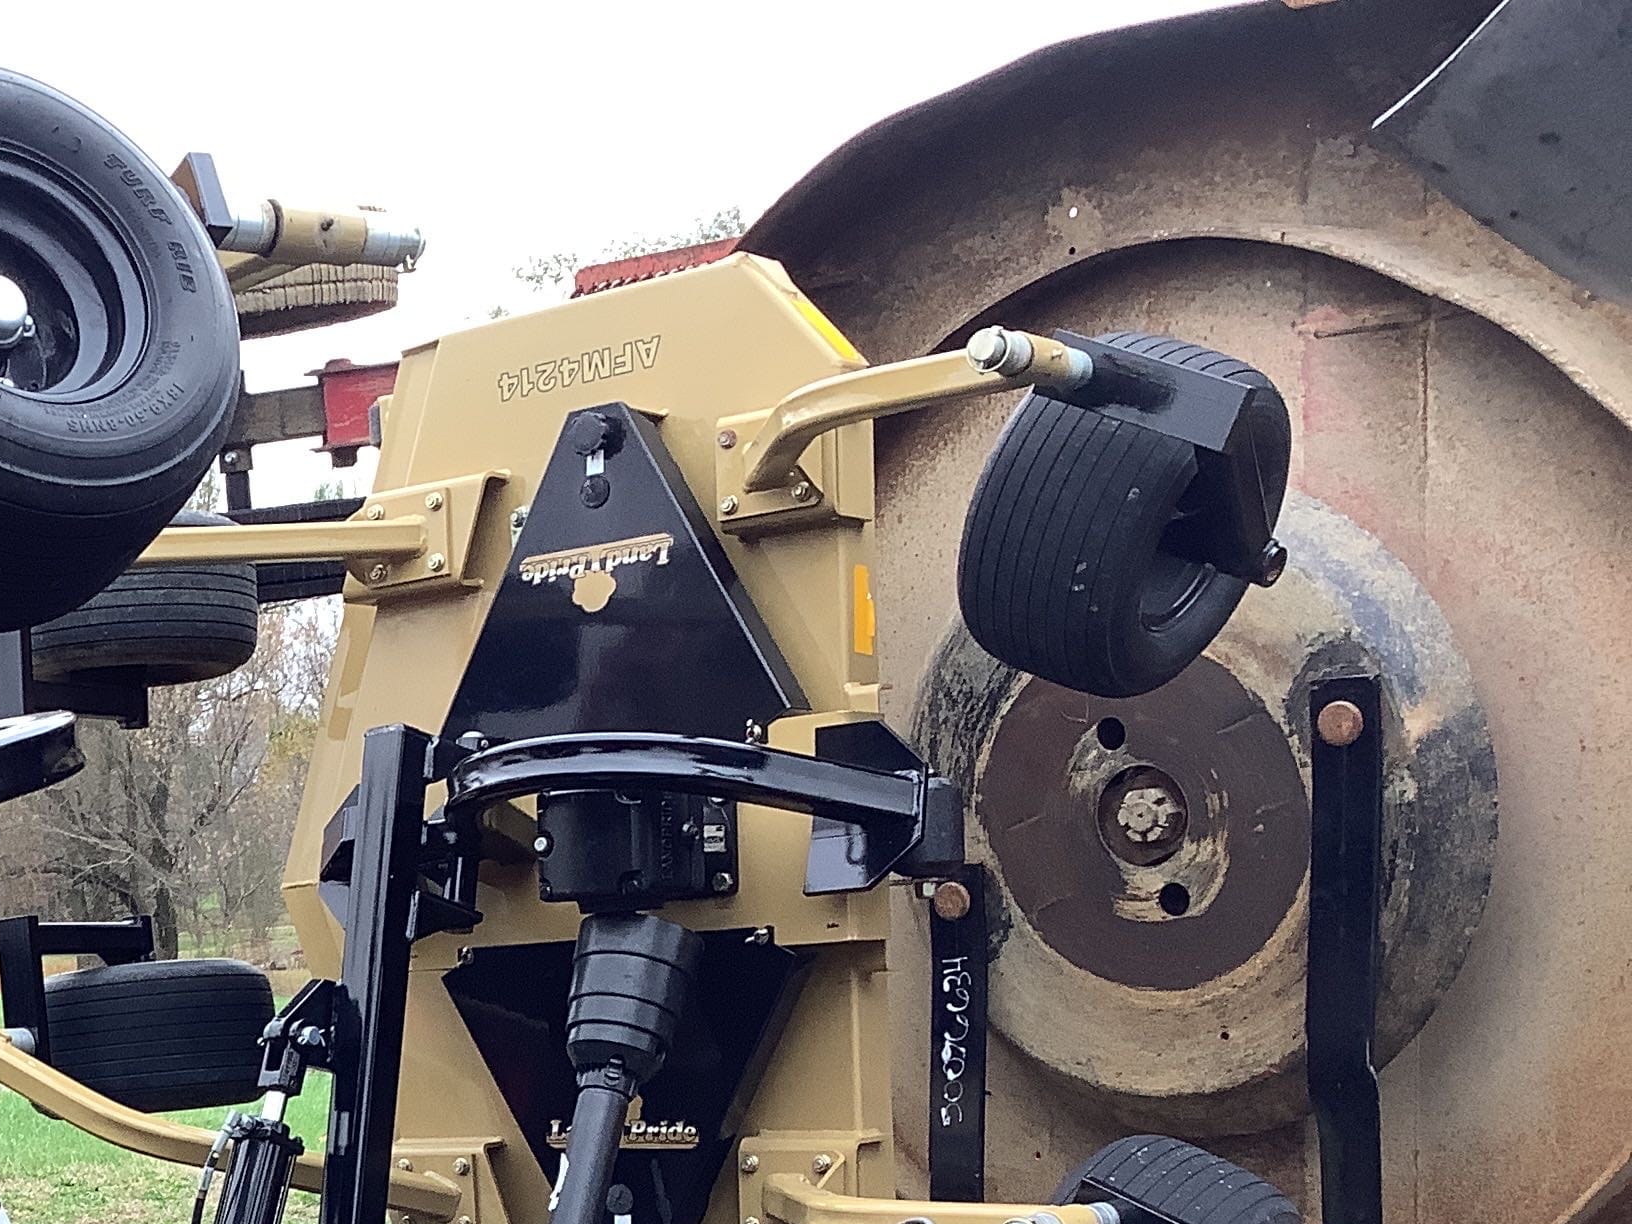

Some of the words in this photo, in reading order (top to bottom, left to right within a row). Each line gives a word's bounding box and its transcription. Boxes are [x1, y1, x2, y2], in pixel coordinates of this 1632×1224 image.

[103, 153, 173, 226] TURF
[167, 240, 197, 294] RIB
[499, 335, 661, 402] AFM4214
[521, 555, 588, 586] Pride
[601, 541, 672, 573] Land
[626, 1119, 698, 1143] Pride
